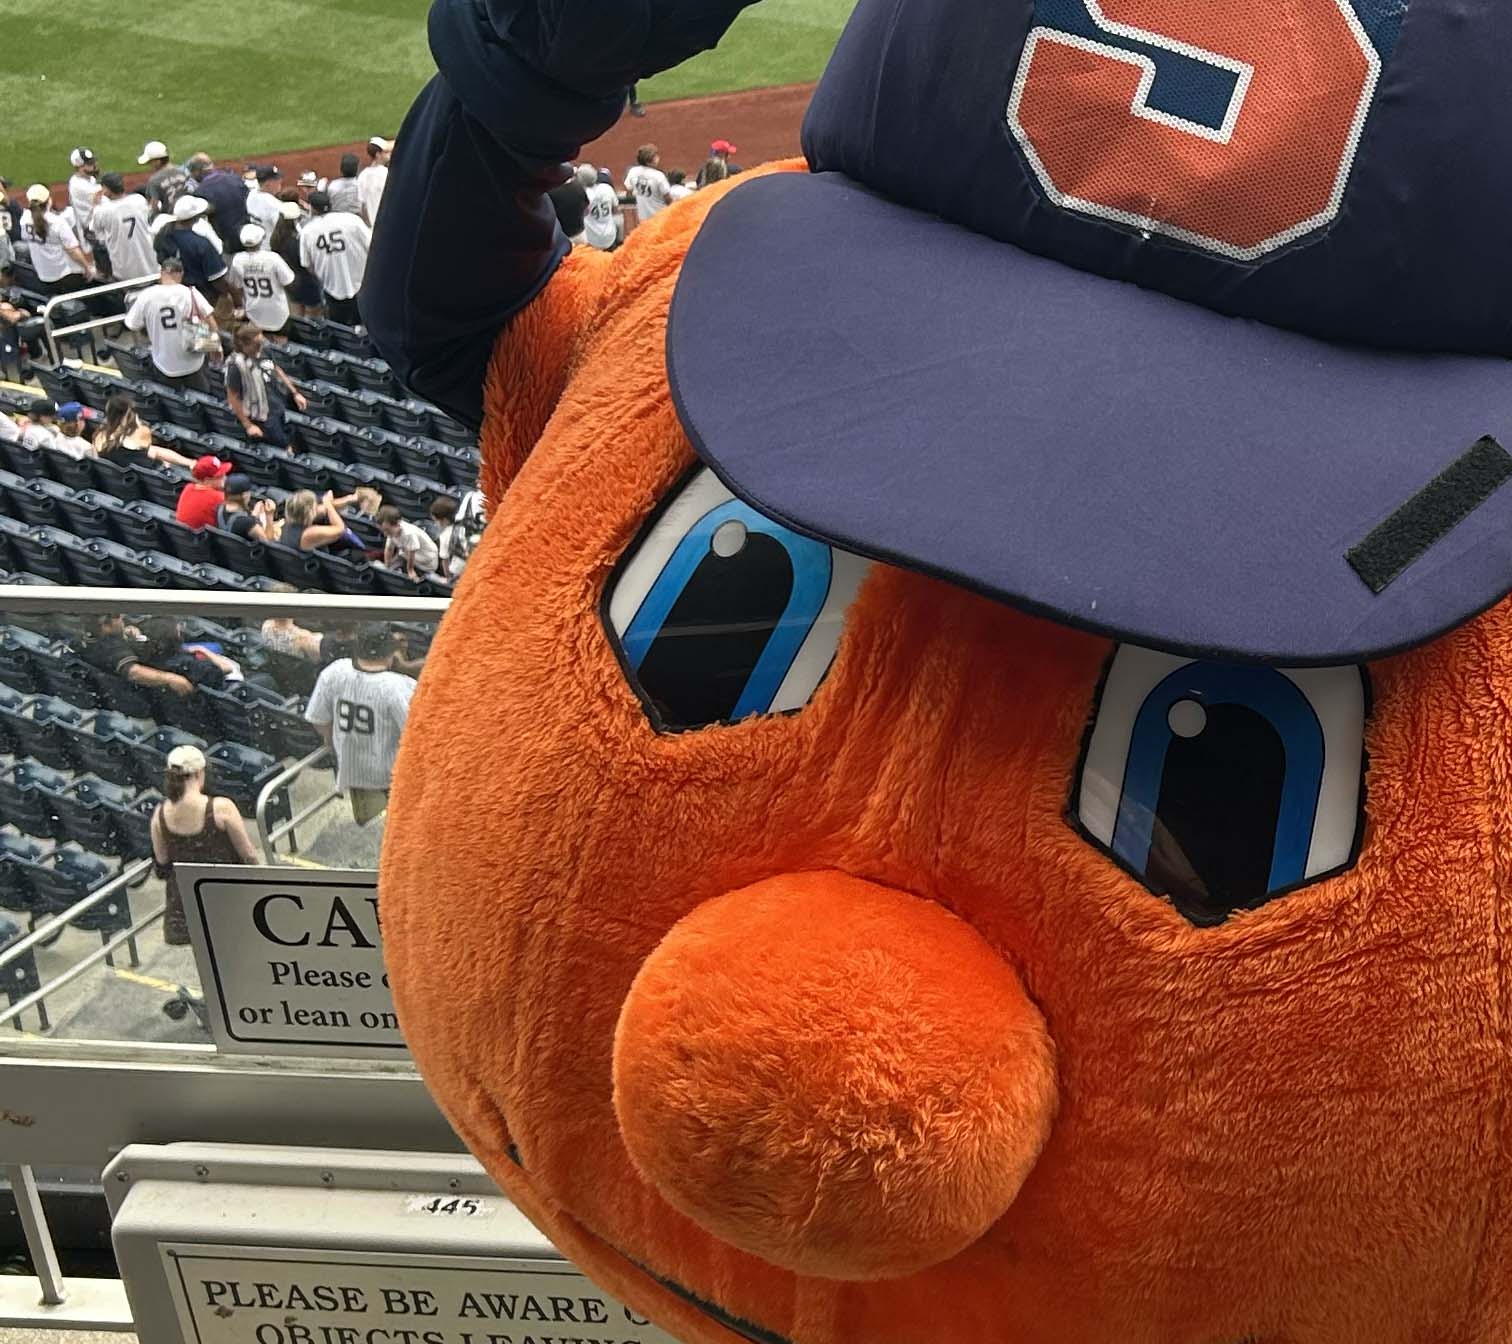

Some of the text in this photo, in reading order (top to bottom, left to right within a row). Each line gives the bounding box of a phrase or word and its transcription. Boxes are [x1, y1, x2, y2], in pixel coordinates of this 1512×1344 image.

[122, 217, 137, 239] 7
[316, 230, 347, 254] 45
[243, 277, 274, 298] 99
[160, 306, 177, 329] 2
[336, 697, 376, 736] 99
[253, 894, 384, 948] CA
[268, 961, 372, 988] Please
[239, 1000, 399, 1030] or lean on
[201, 1280, 369, 1313] PLEASE
[380, 1289, 439, 1316] BE
[458, 1293, 609, 1324] AWARE
